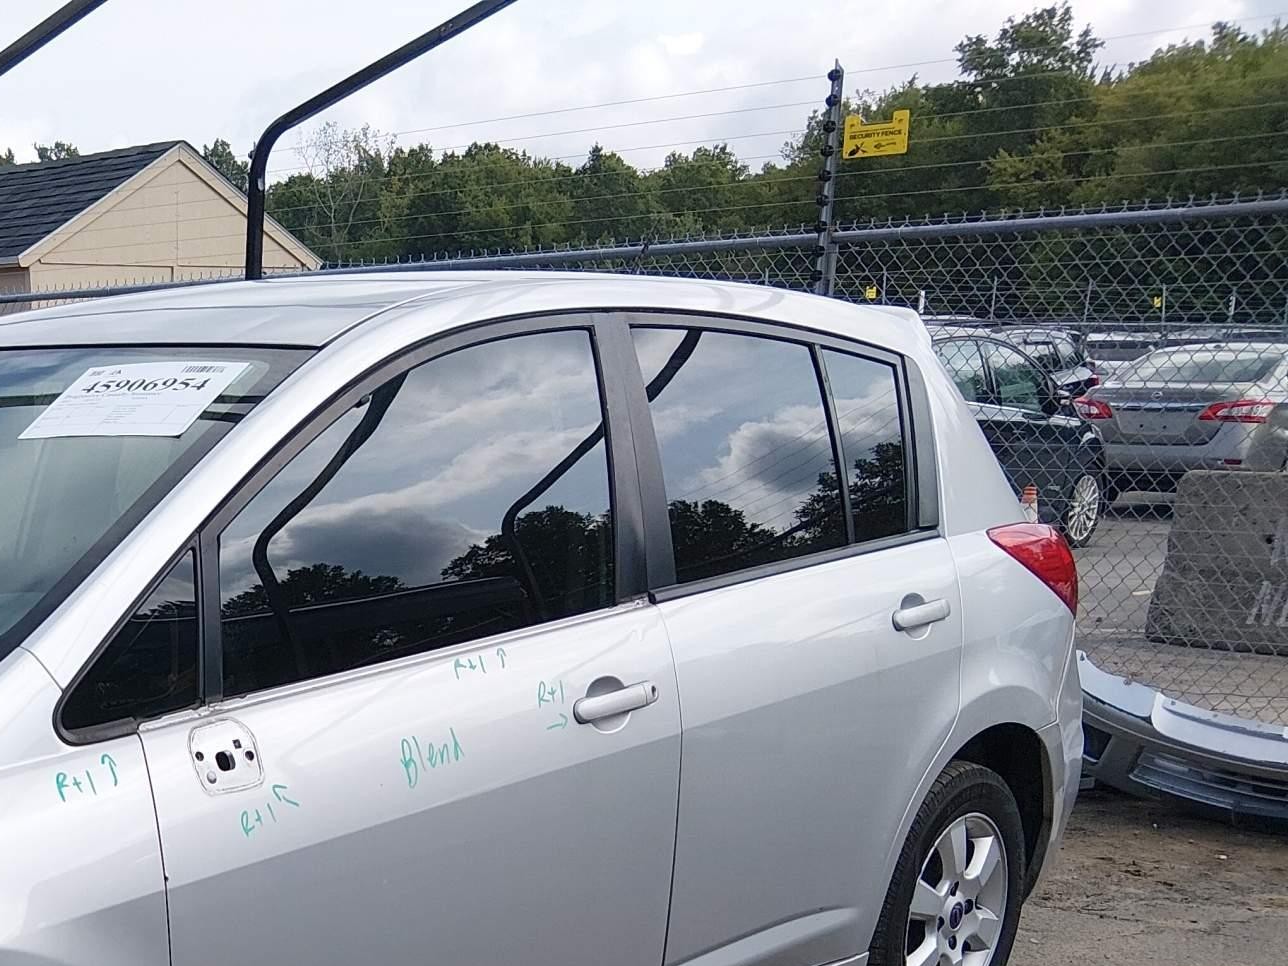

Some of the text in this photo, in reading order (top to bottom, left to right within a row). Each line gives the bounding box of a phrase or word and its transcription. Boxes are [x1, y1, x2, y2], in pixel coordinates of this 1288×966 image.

[849, 132, 880, 140] SECURITY
[881, 129, 902, 137] FENCE
[82, 377, 212, 394] 45906954
[400, 727, 465, 789] Blend
